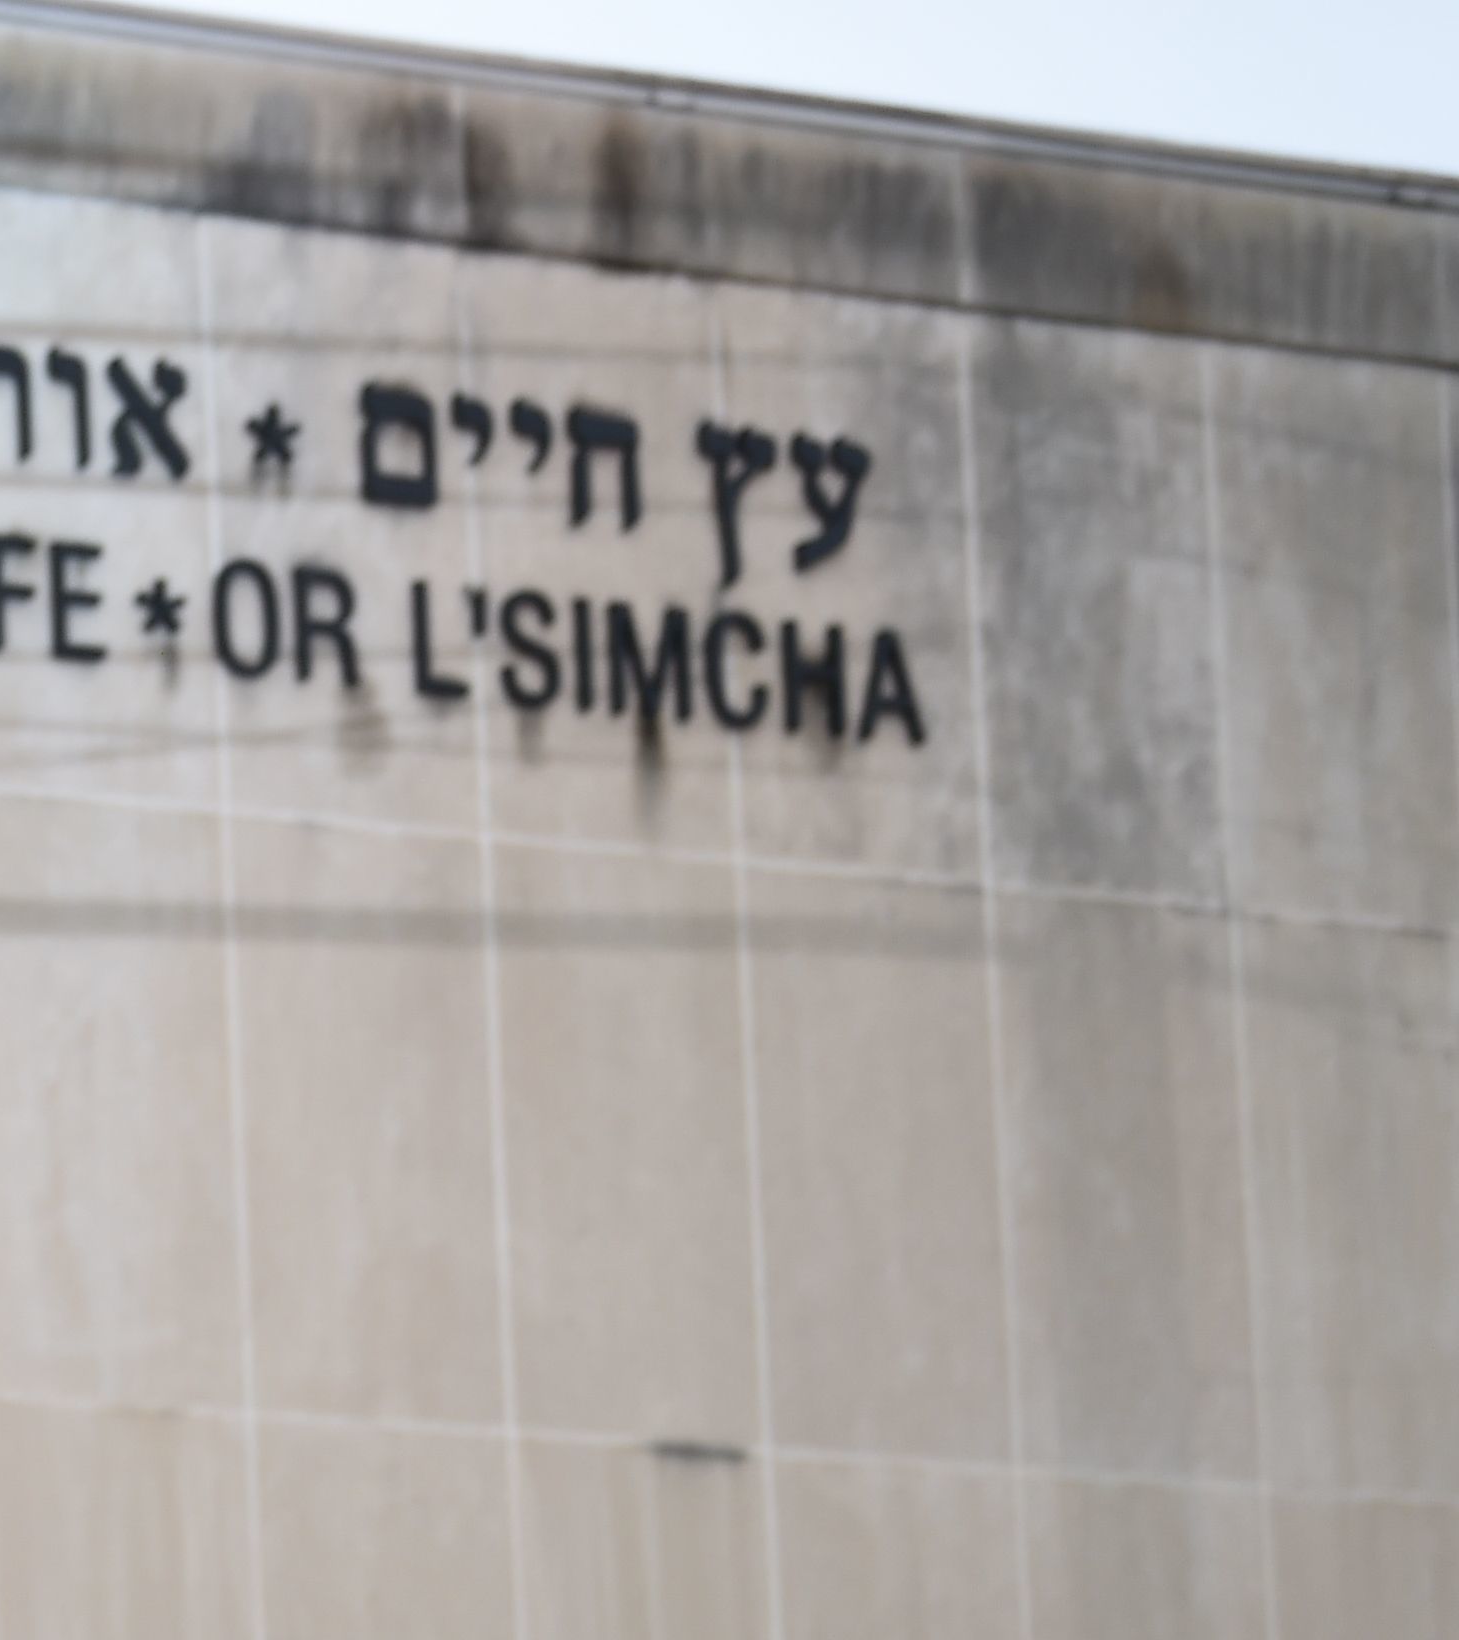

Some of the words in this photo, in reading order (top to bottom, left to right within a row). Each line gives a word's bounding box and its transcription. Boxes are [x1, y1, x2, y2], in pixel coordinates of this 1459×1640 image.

[357, 380, 644, 534] חיים
[693, 418, 874, 592] עץ
[210, 557, 363, 694] OR
[410, 577, 929, 748] L'SIMCHA
